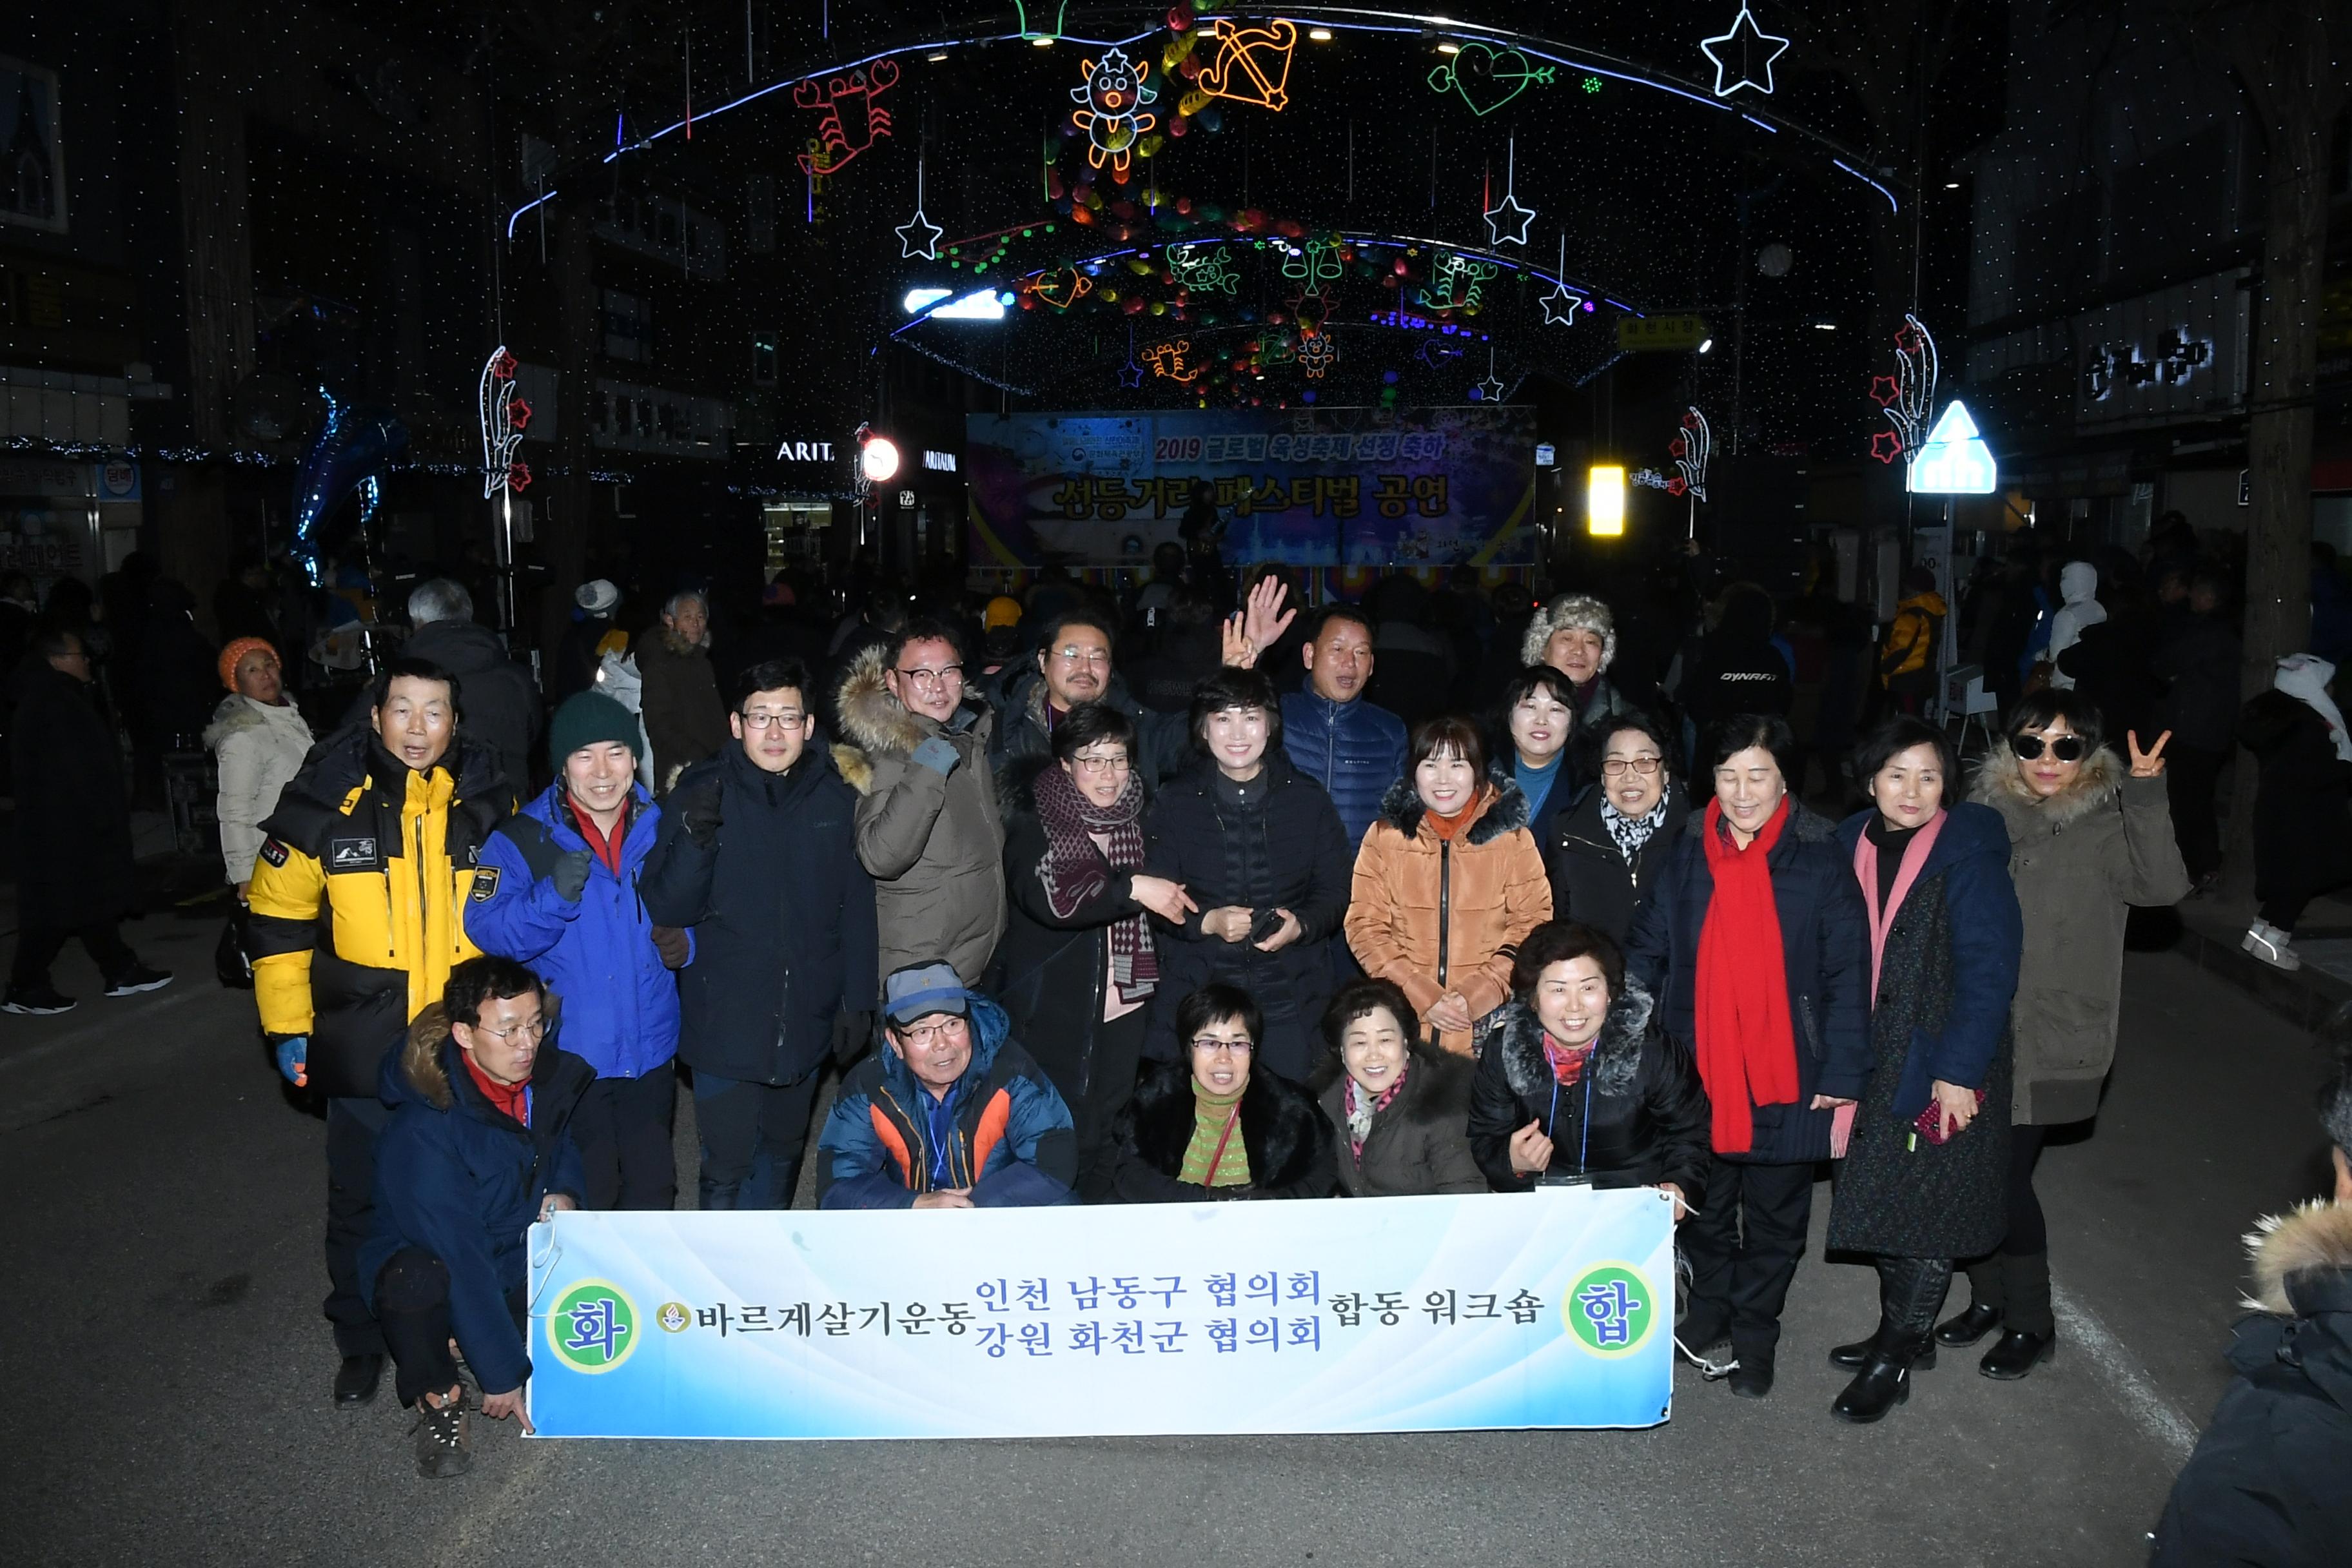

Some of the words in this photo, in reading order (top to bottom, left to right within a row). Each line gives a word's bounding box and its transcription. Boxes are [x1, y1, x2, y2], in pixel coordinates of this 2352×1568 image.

[1156, 438, 1200, 460] 2019
[1206, 435, 1267, 461] 글로벌
[1271, 435, 1351, 461] 육성축제
[1356, 433, 1398, 460] 선정
[1402, 433, 1446, 460] 축하
[1372, 475, 1449, 518] 공연
[975, 1278, 1051, 1312] 인천
[1068, 1276, 1188, 1311] 남동구
[1203, 1270, 1320, 1308] 협의회
[1327, 1291, 1410, 1328] 합동
[1421, 1288, 1546, 1326] 워크숍
[565, 1298, 627, 1360] 화
[696, 1302, 977, 1338] 바르게살기운동
[1578, 1280, 1640, 1346] 합
[975, 1322, 1053, 1358] 강원
[1068, 1320, 1189, 1356] 화천군
[1204, 1315, 1321, 1353] 협의회
